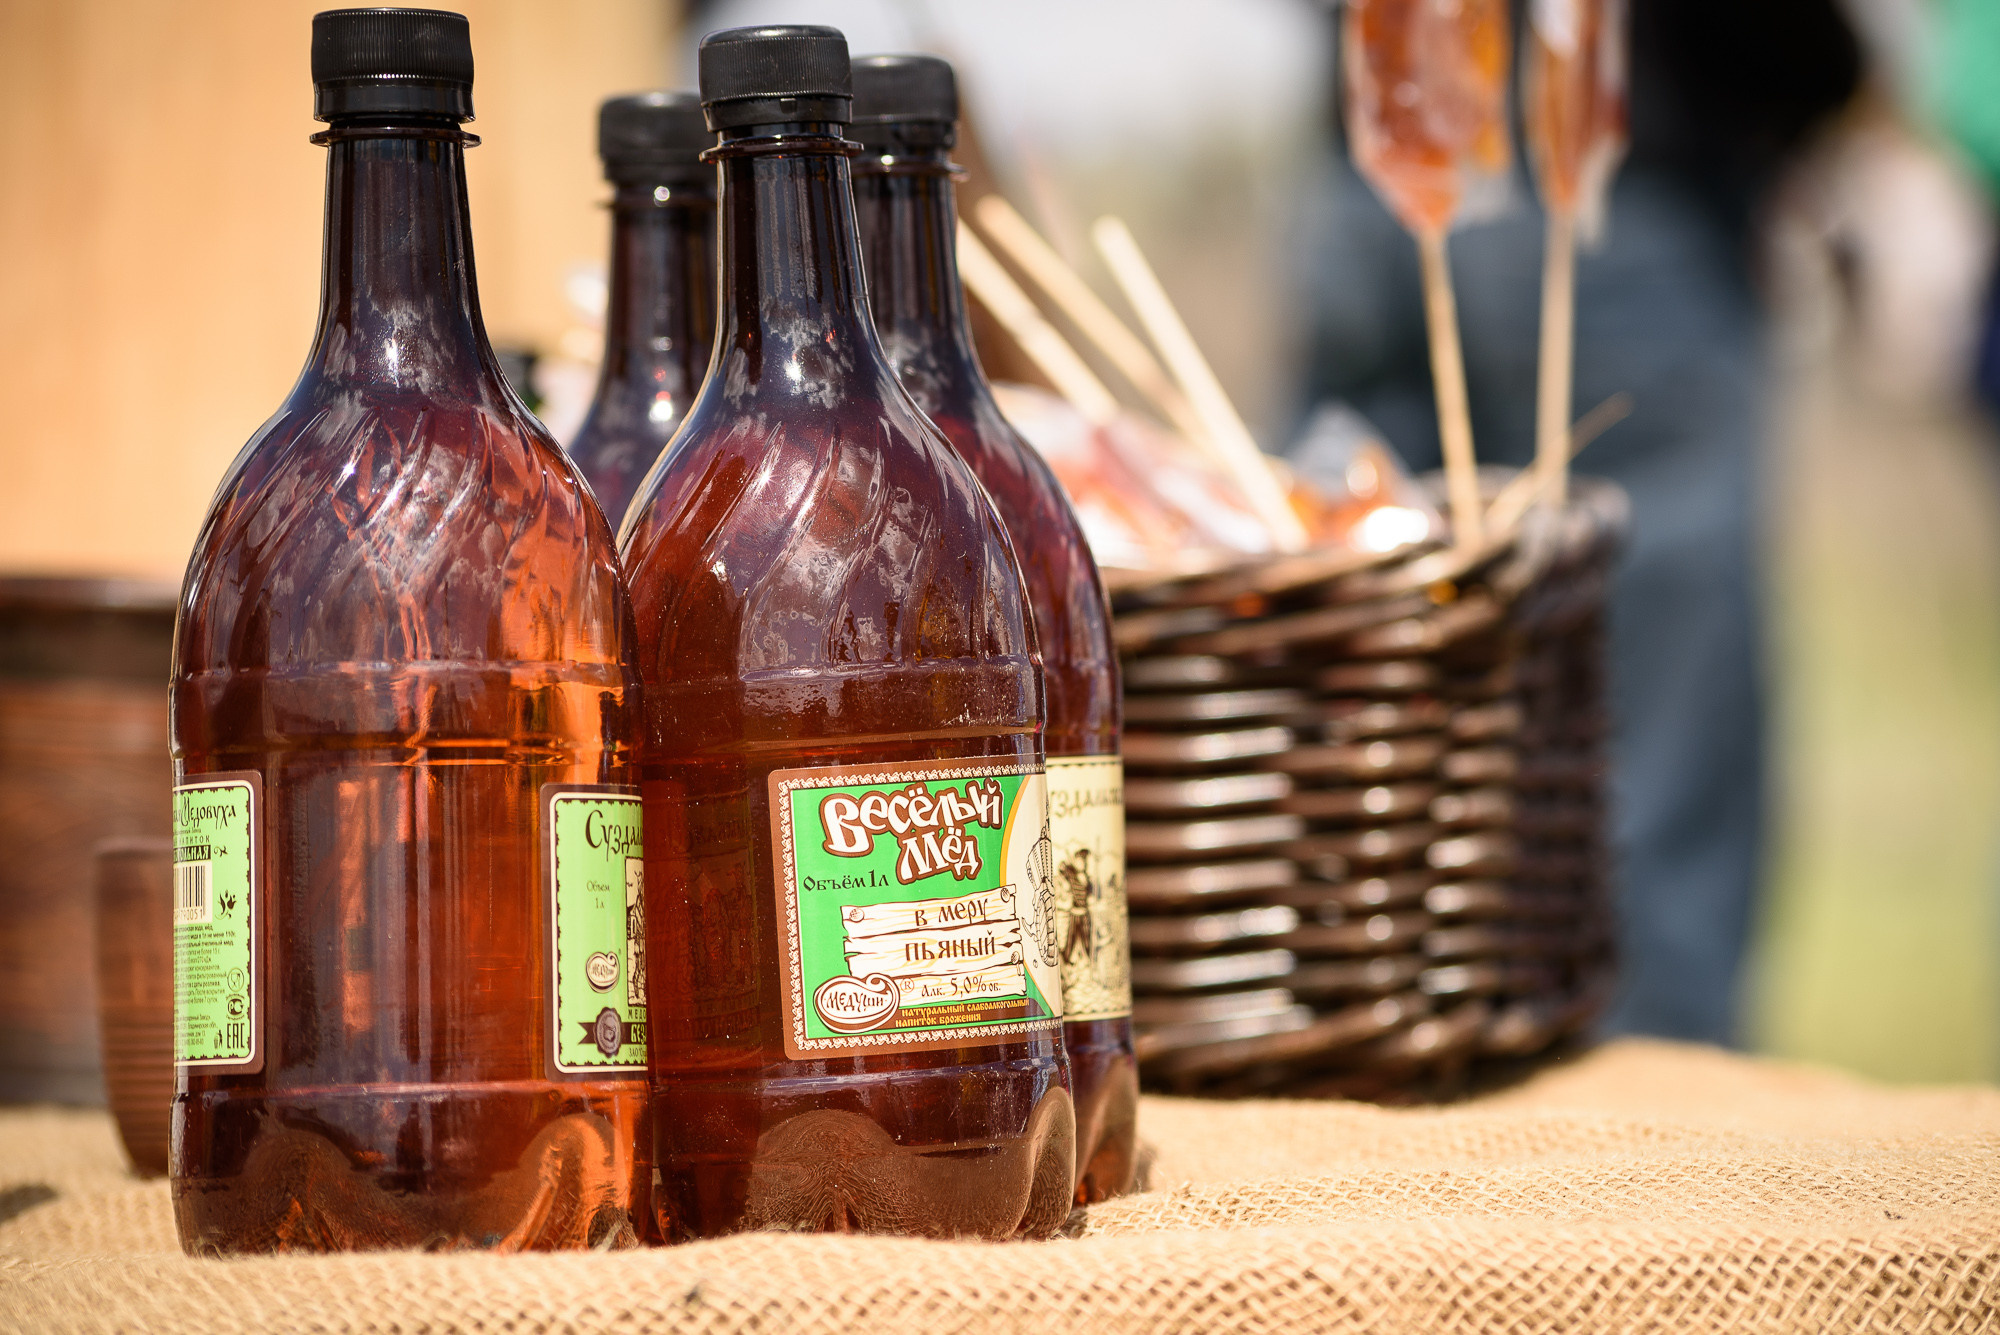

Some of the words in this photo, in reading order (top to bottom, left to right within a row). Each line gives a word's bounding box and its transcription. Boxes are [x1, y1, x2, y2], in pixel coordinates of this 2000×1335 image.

[822, 780, 1002, 854] Весёлый
[179, 834, 210, 846] АПИТОК
[899, 827, 979, 881] Мёд
[802, 874, 867, 892] Объём
